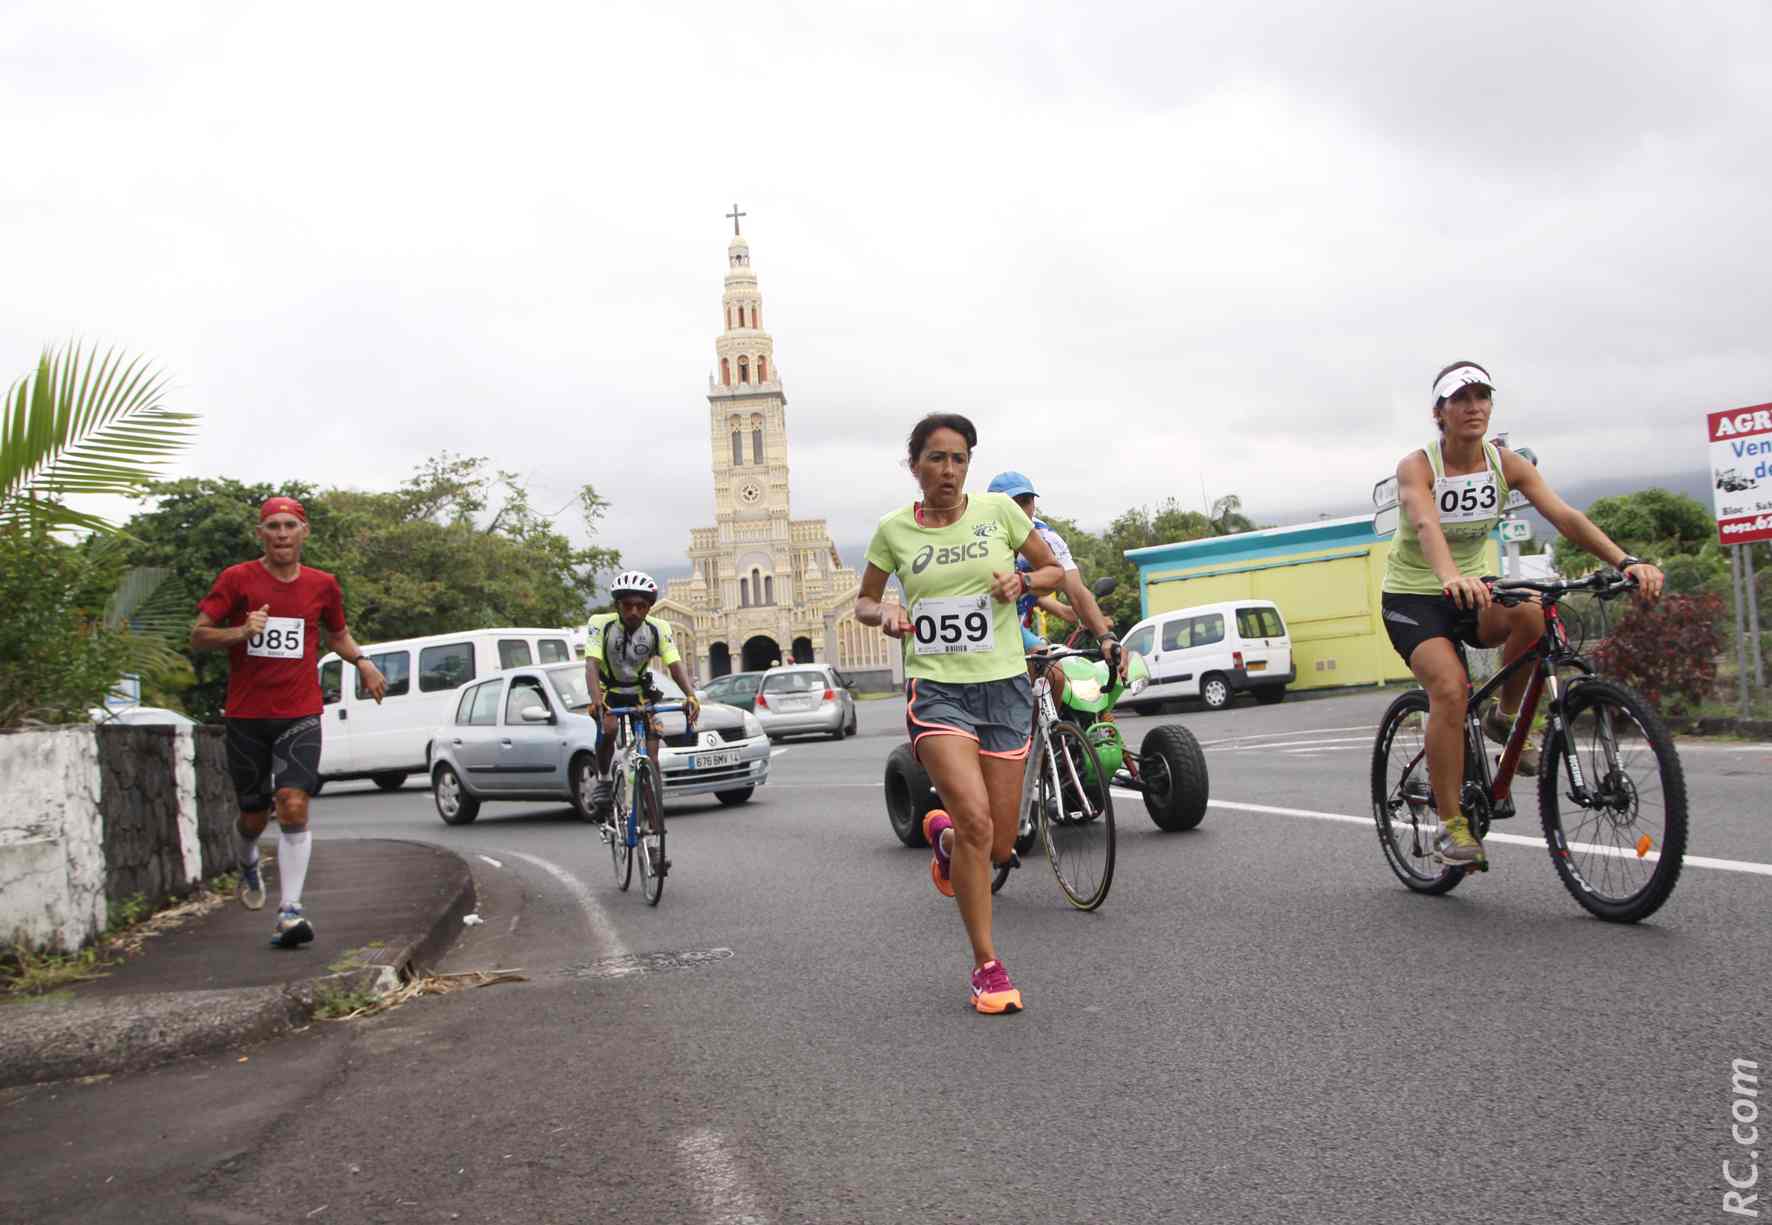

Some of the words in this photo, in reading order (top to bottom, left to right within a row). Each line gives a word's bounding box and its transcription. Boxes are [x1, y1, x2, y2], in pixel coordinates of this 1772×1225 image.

[1715, 410, 1772, 437] AGR
[1440, 485, 1496, 512] 053
[249, 629, 299, 650] 085
[915, 612, 988, 644] 059
